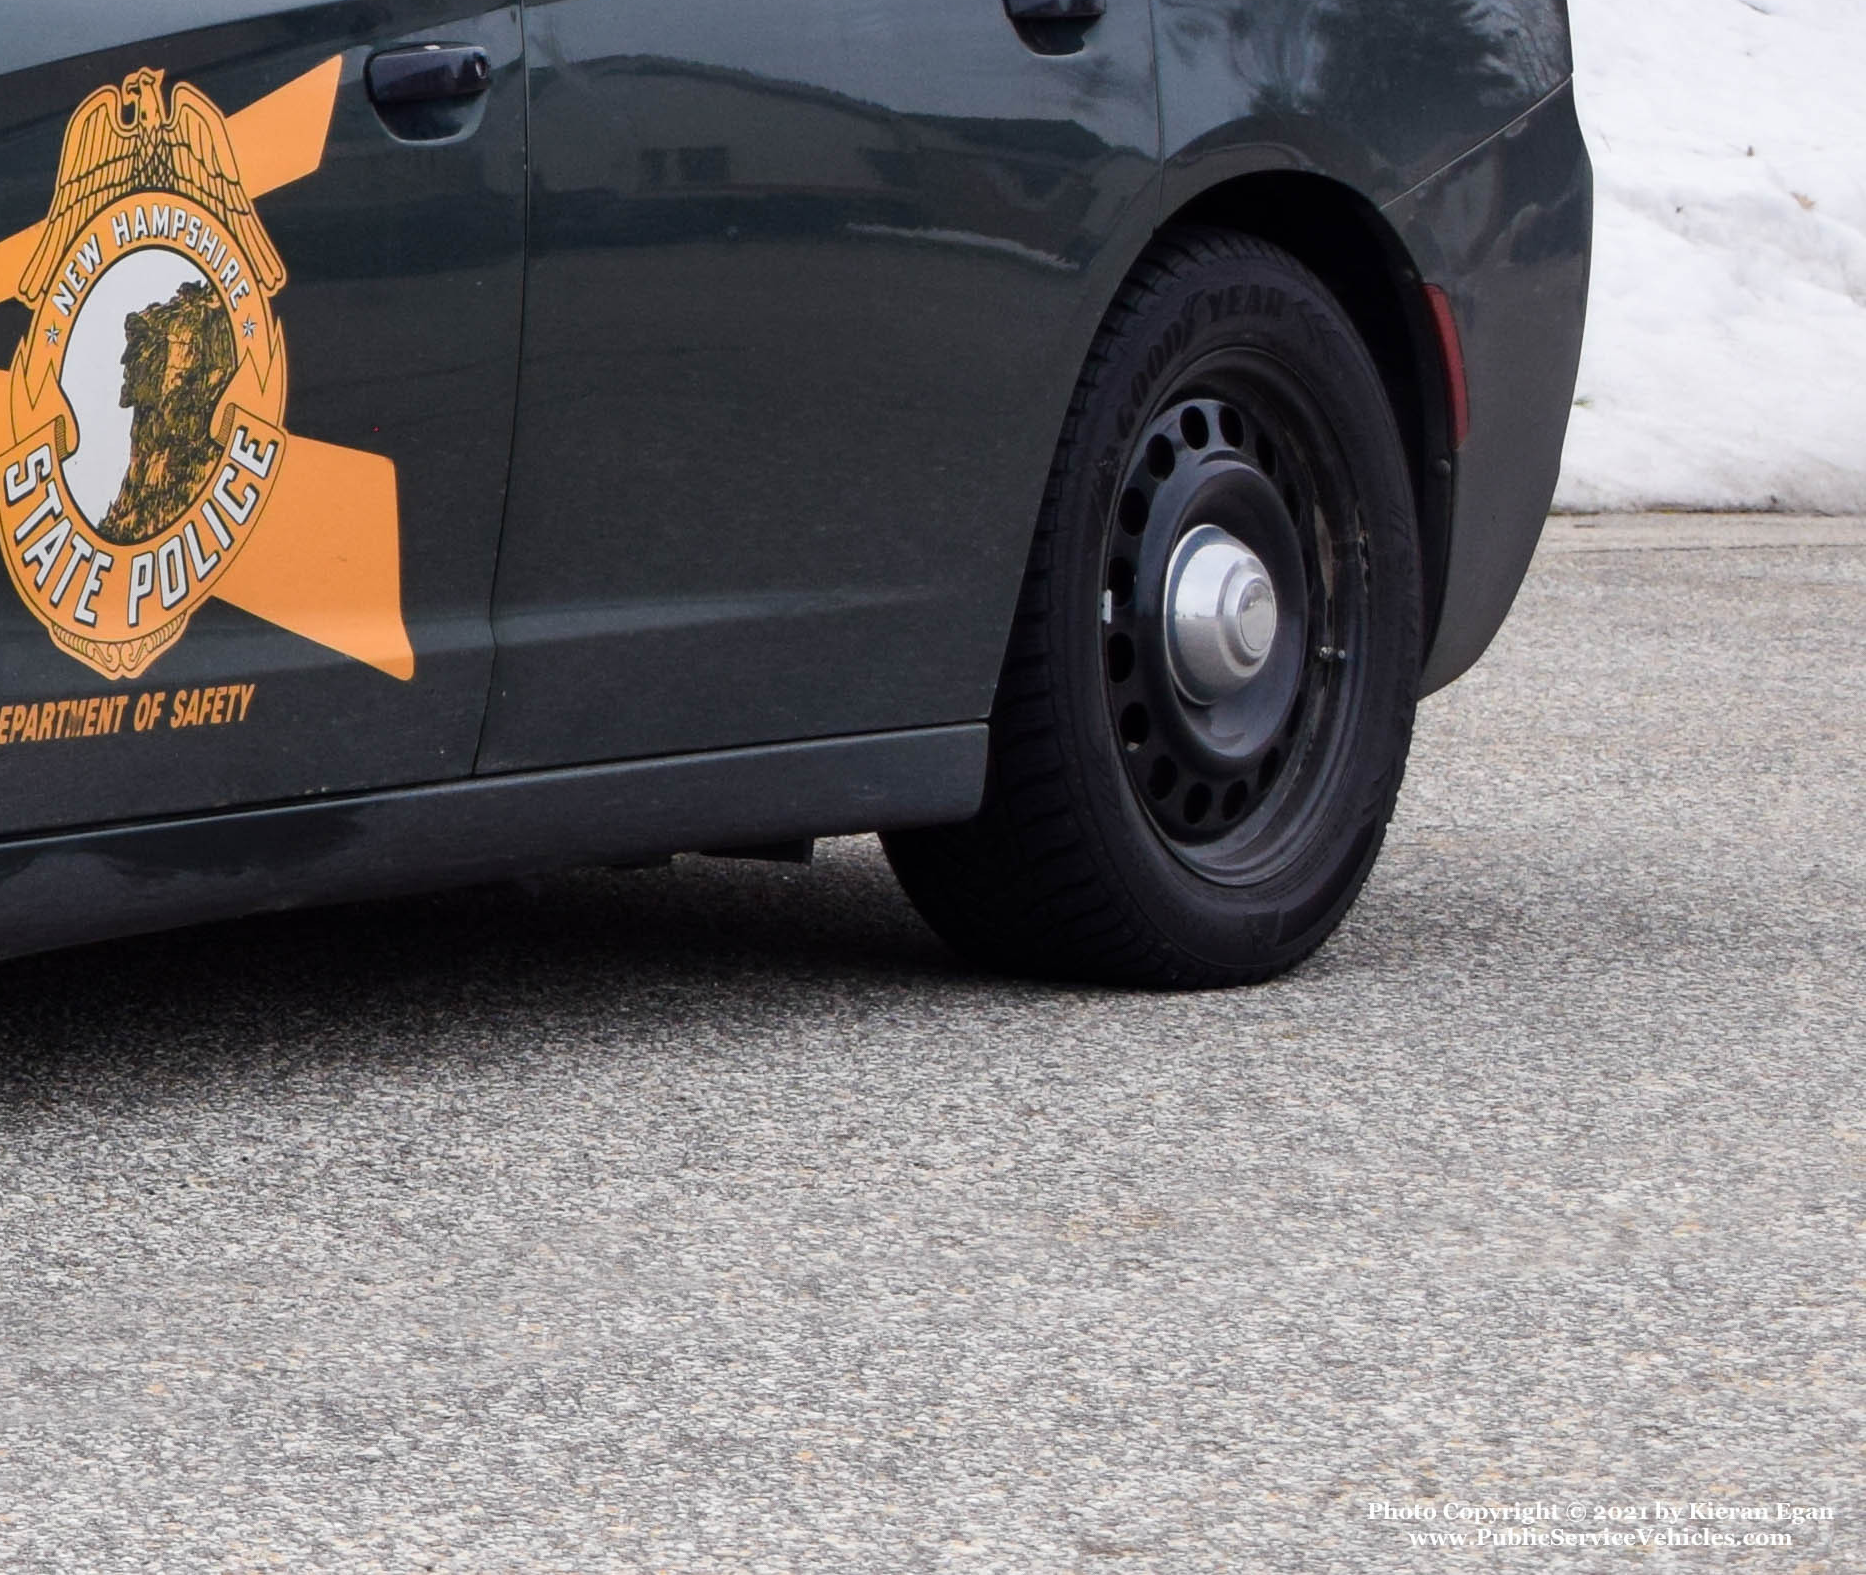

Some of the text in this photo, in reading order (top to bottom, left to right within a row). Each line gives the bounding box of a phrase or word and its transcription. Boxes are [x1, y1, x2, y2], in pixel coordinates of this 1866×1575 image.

[52, 204, 250, 317] NEW HAMPSHIRE
[4, 425, 280, 628] STATE POLICE
[132, 692, 166, 733] OF
[169, 683, 255, 729] SAFETY
